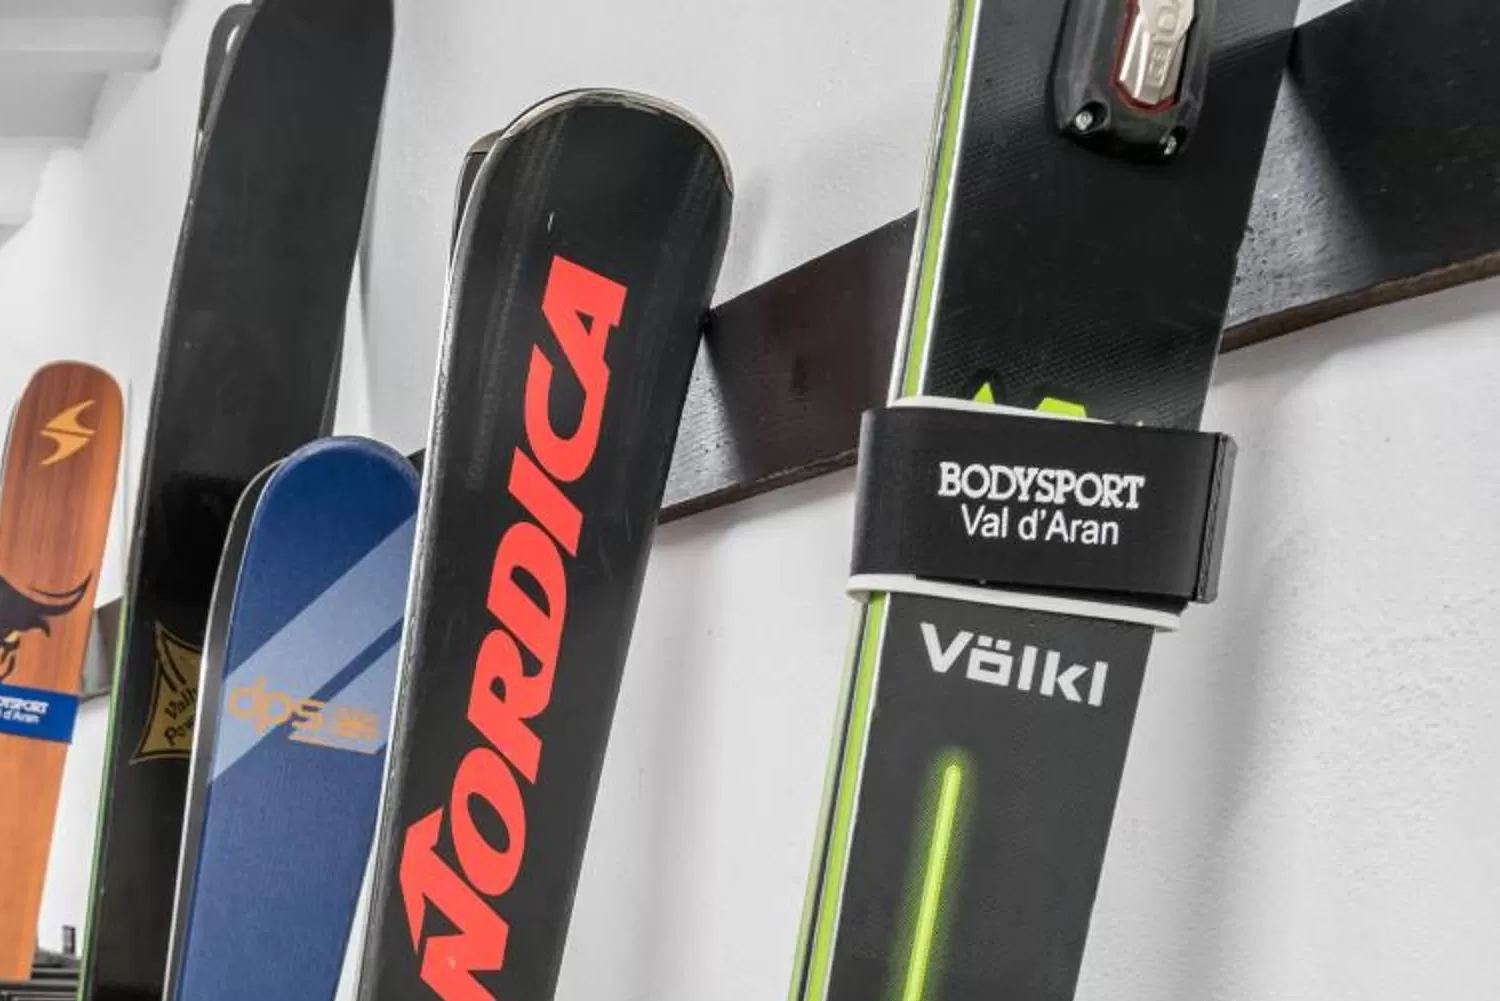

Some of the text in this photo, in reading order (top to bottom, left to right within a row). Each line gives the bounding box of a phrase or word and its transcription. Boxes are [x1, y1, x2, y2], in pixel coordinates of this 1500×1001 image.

[937, 461, 1146, 510] BODYSPORT
[961, 503, 1120, 546] Val d'Aran
[920, 621, 1110, 708] Völkl
[228, 675, 326, 737] dps
